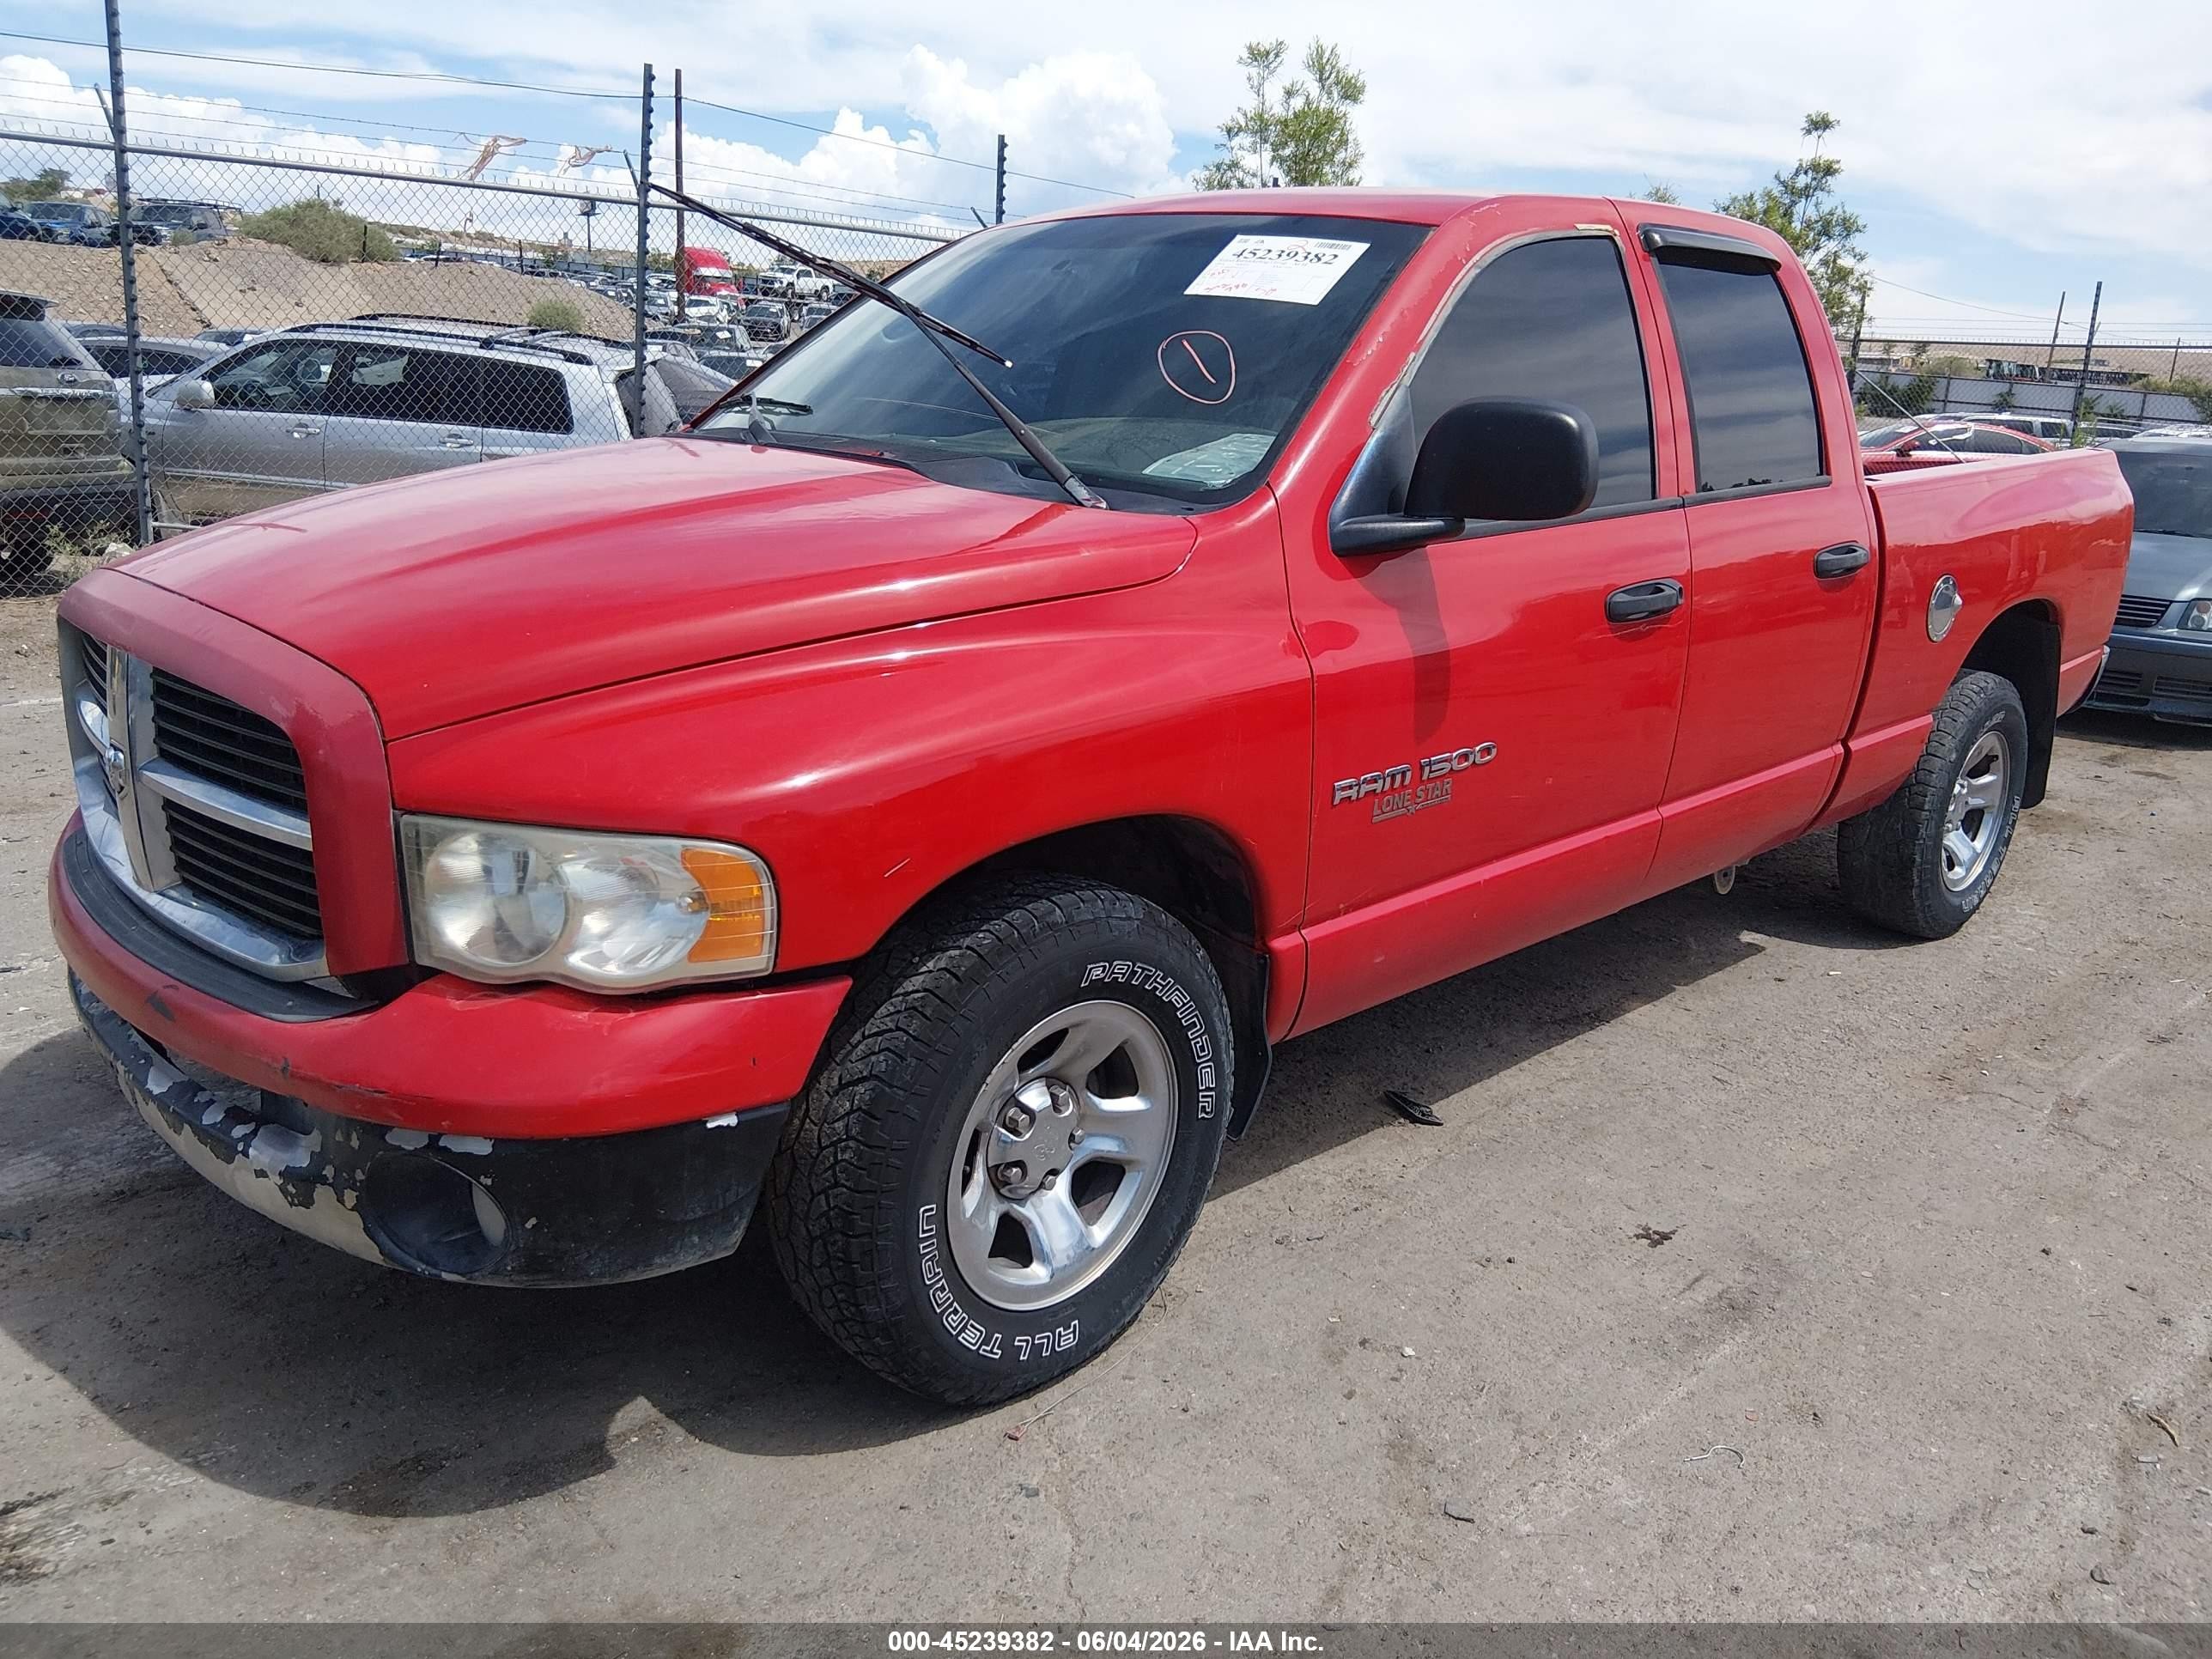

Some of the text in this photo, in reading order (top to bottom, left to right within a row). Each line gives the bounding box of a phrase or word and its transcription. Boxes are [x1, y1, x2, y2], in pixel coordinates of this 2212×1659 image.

[1232, 248, 1339, 264] 45239382
[1333, 742, 1498, 805] RAM 1500
[1374, 779, 1452, 815] LONE STAR
[1080, 960, 1216, 1120] PATHFINDER
[919, 1204, 1079, 1361] ALL TERRAIN
